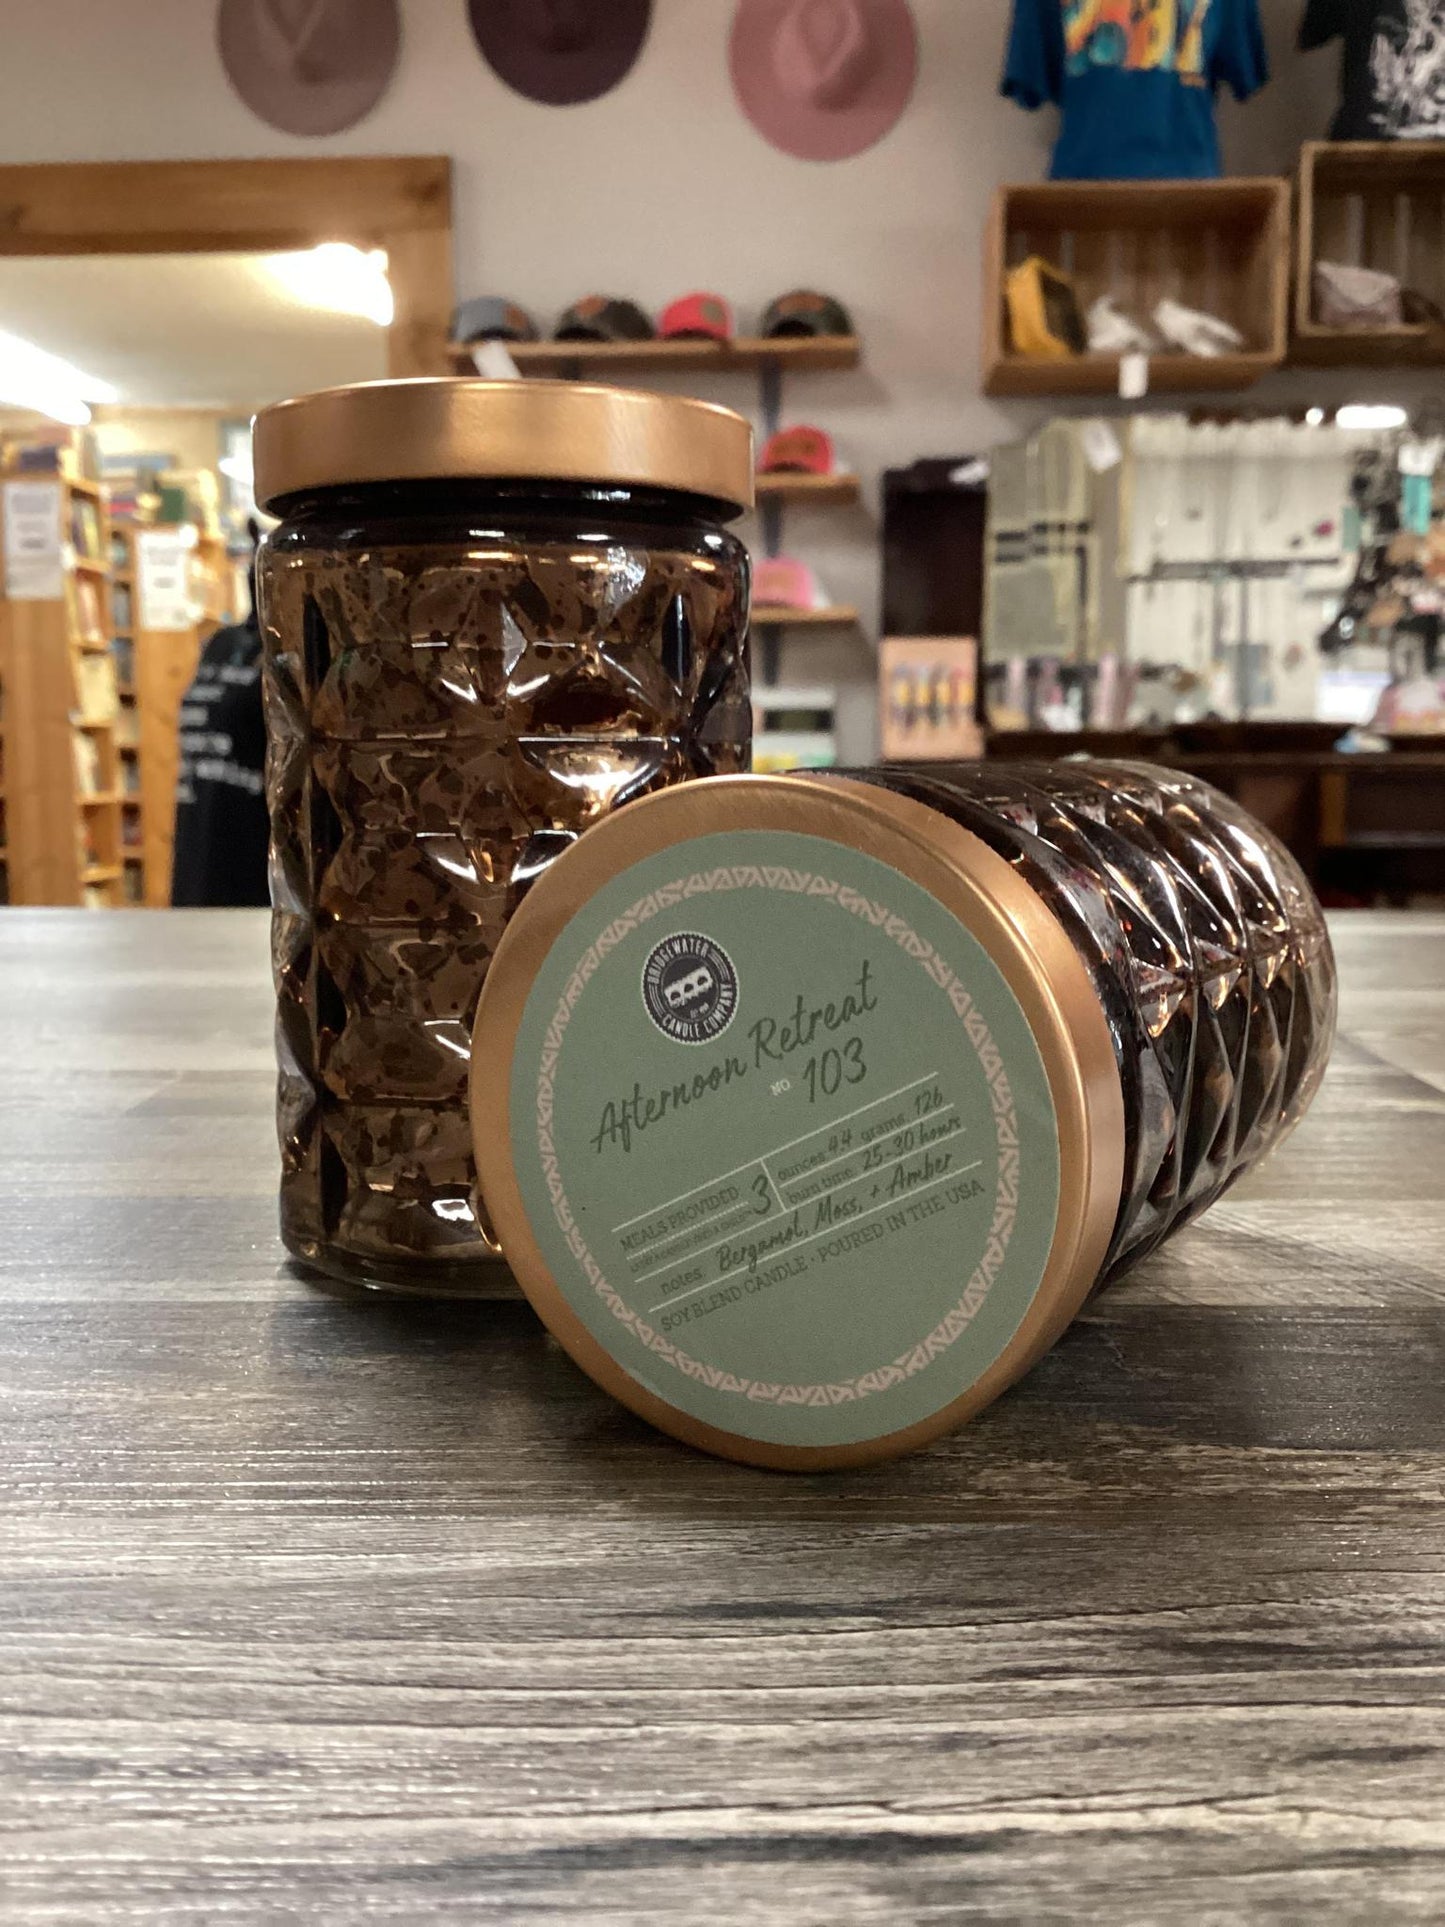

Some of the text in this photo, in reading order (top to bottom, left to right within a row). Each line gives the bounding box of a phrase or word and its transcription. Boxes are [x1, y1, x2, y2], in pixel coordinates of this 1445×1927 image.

[647, 938, 709, 985] BRIDGEWATER
[662, 983, 734, 1038] CANDLE COMPANY
[590, 959, 878, 1153] Afternoon Retreat
[803, 1037, 867, 1103] 103
[828, 1128, 852, 1152] 4.4
[914, 1086, 943, 1115] 126
[920, 1116, 961, 1144] hours
[886, 1153, 952, 1198] Amber
[620, 1220, 668, 1251] MEALS
[668, 1186, 739, 1229] PROVIDED
[752, 1174, 771, 1215] 3
[660, 1179, 985, 1332] SOY BLEND CANDLE POURED IN THE USA
